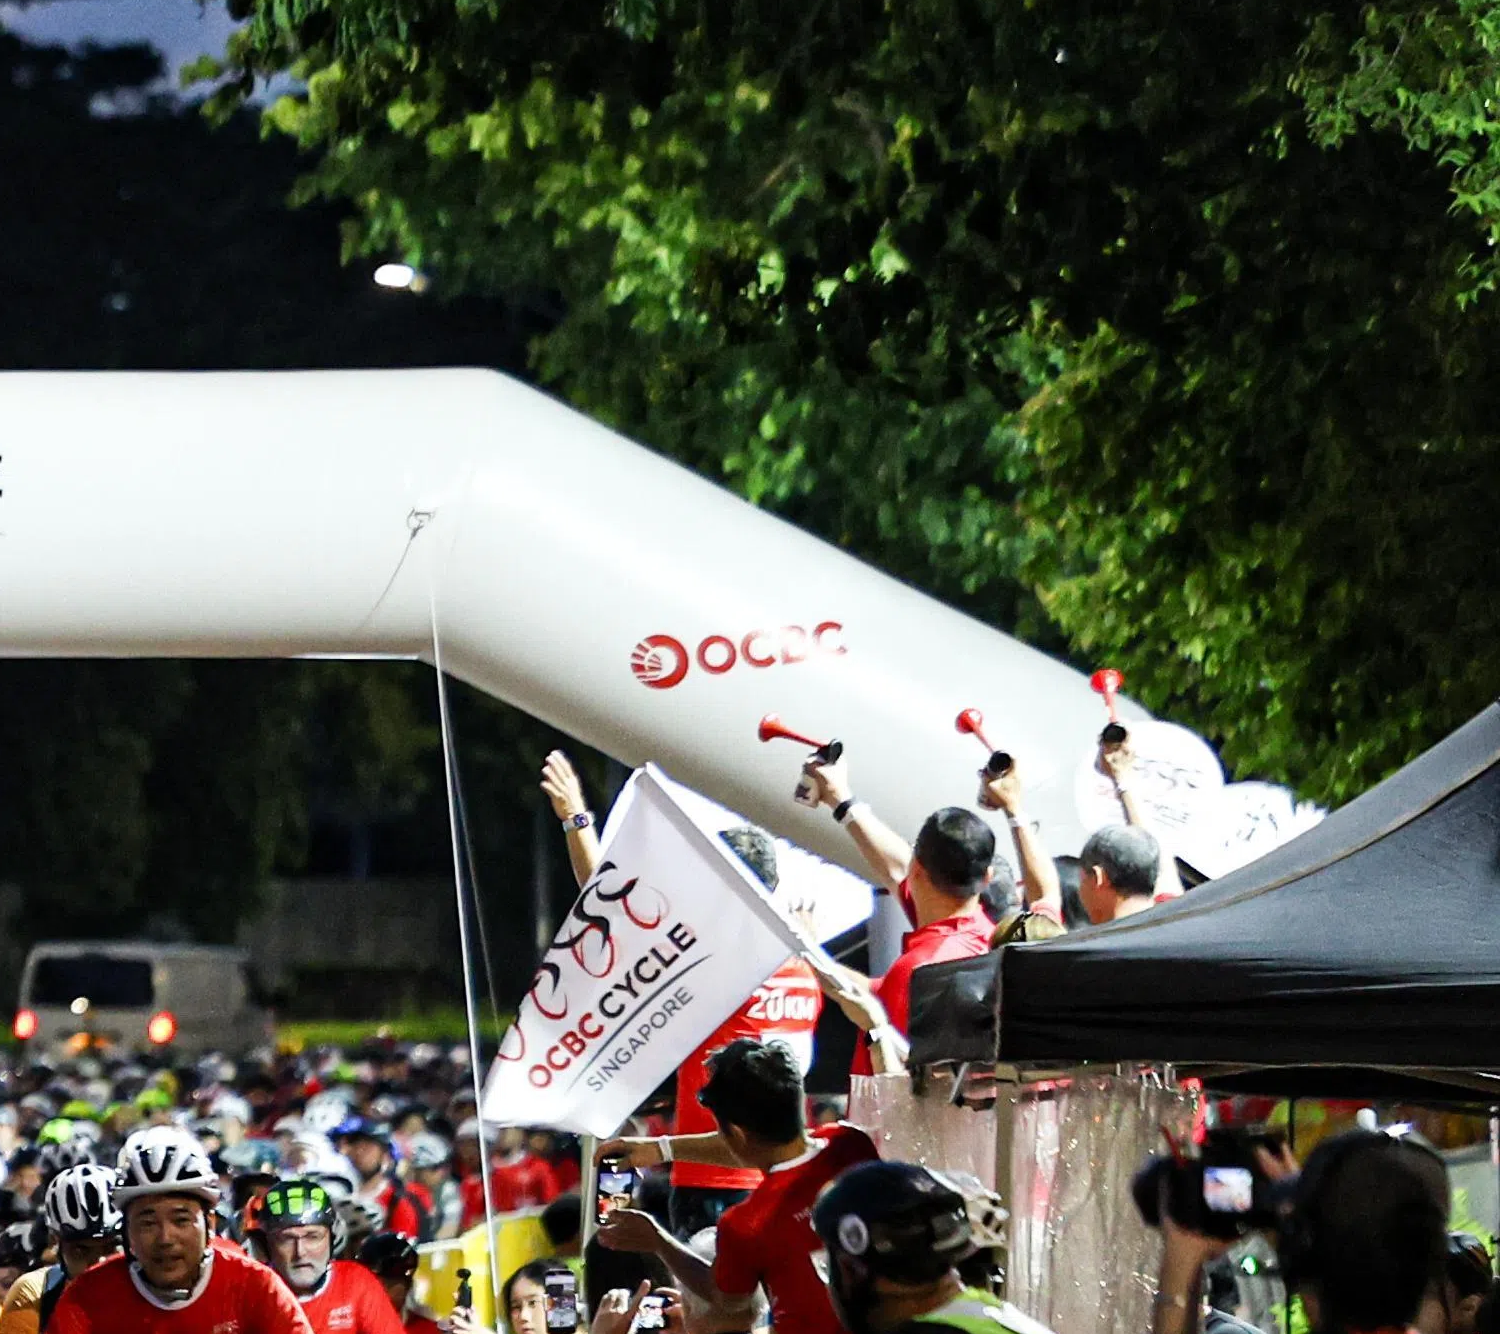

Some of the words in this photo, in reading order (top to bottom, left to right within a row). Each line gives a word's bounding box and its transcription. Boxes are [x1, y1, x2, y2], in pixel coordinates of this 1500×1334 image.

[695, 620, 849, 676] OCBC
[528, 1011, 606, 1089] OCBC
[599, 921, 698, 1020] CYCLE
[586, 986, 694, 1092] SINGAPORE
